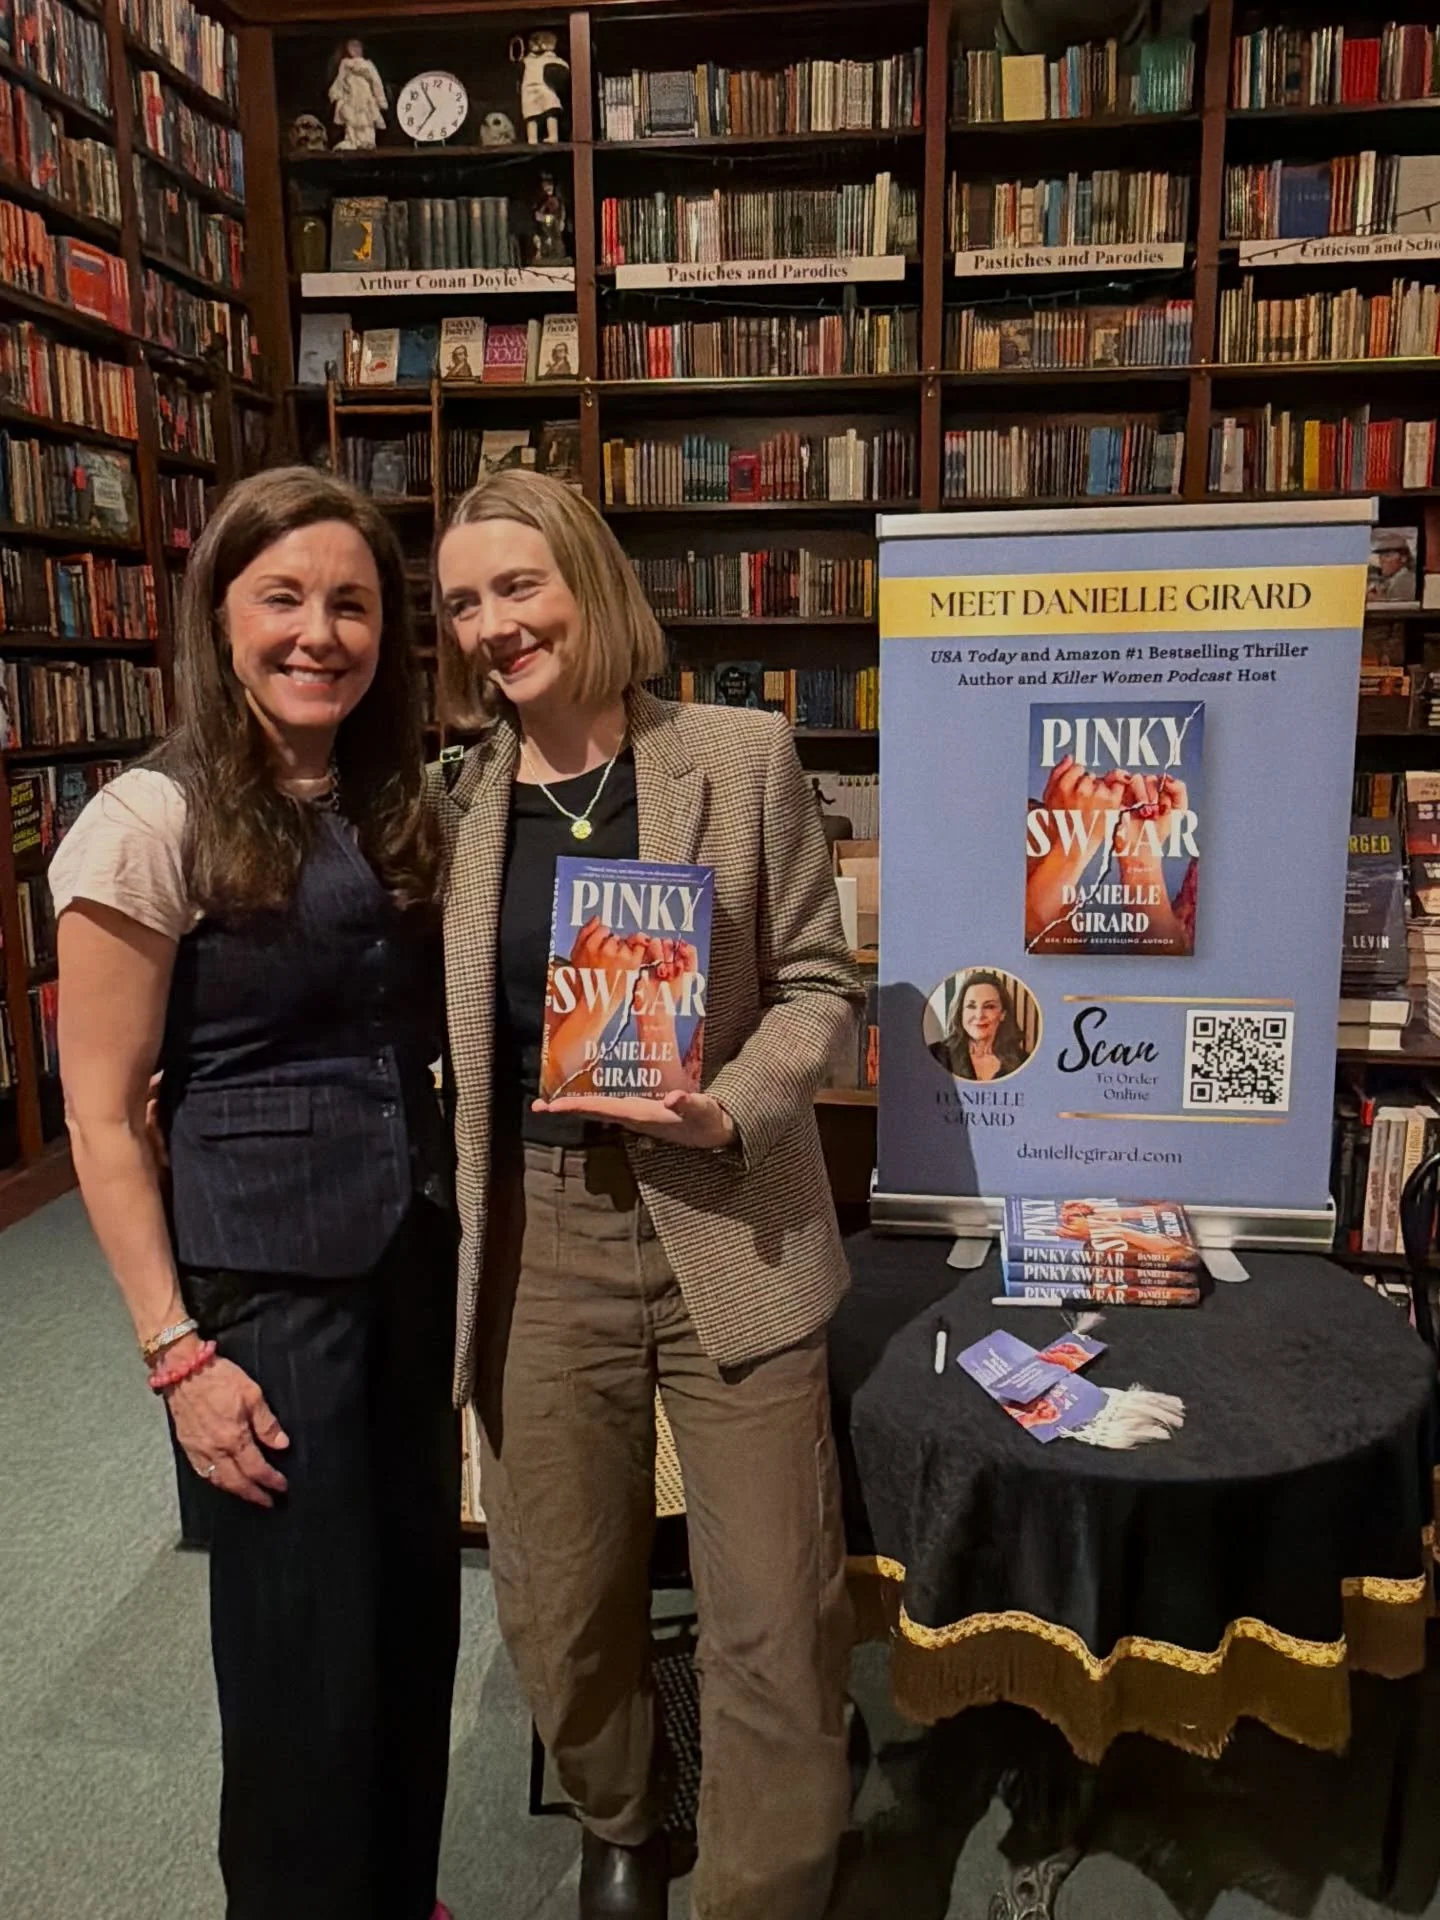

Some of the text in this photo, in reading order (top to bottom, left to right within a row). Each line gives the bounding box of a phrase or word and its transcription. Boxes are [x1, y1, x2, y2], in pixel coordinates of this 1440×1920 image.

[1300, 242, 1369, 258] Criticism
[1374, 239, 1401, 254] and
[974, 249, 1164, 270] Pastiches and Parodies
[356, 271, 518, 291] Arthur Conan Doyle
[667, 262, 848, 282] Pastiches and Parodies
[930, 582, 1312, 618] MEET DANIELLE GIRARD
[930, 642, 1309, 665] USA Today and Amazon #1 Bestselling Thriller
[957, 668, 1277, 686] Author and Killer Women Podcast Host
[1040, 717, 1194, 768] PINKY
[1026, 808, 1200, 858] SWEAR
[1062, 884, 1161, 905] DANIELLE
[569, 879, 704, 932] PINKY
[1071, 912, 1150, 933] GIRARD
[1352, 935, 1390, 950] LEVIN
[552, 965, 707, 1017] SWEAR
[1057, 1006, 1159, 1072] Scan
[584, 1040, 673, 1061] DANIELLE
[592, 1067, 663, 1088] GIRARD
[1096, 1072, 1159, 1086] To Order
[936, 1091, 1025, 1107] DANIELLE
[1103, 1087, 1150, 1101] Online
[944, 1111, 1015, 1127] GIRARD
[1017, 1143, 1183, 1165] daniellegirard.com
[1023, 1247, 1068, 1262] PINKY
[1072, 1250, 1125, 1266] SWEAR
[1023, 1263, 1069, 1280] PINKY
[1072, 1266, 1125, 1283] SWEAR
[1024, 1286, 1070, 1299] PINKY
[1072, 1288, 1125, 1304] SWEAR
